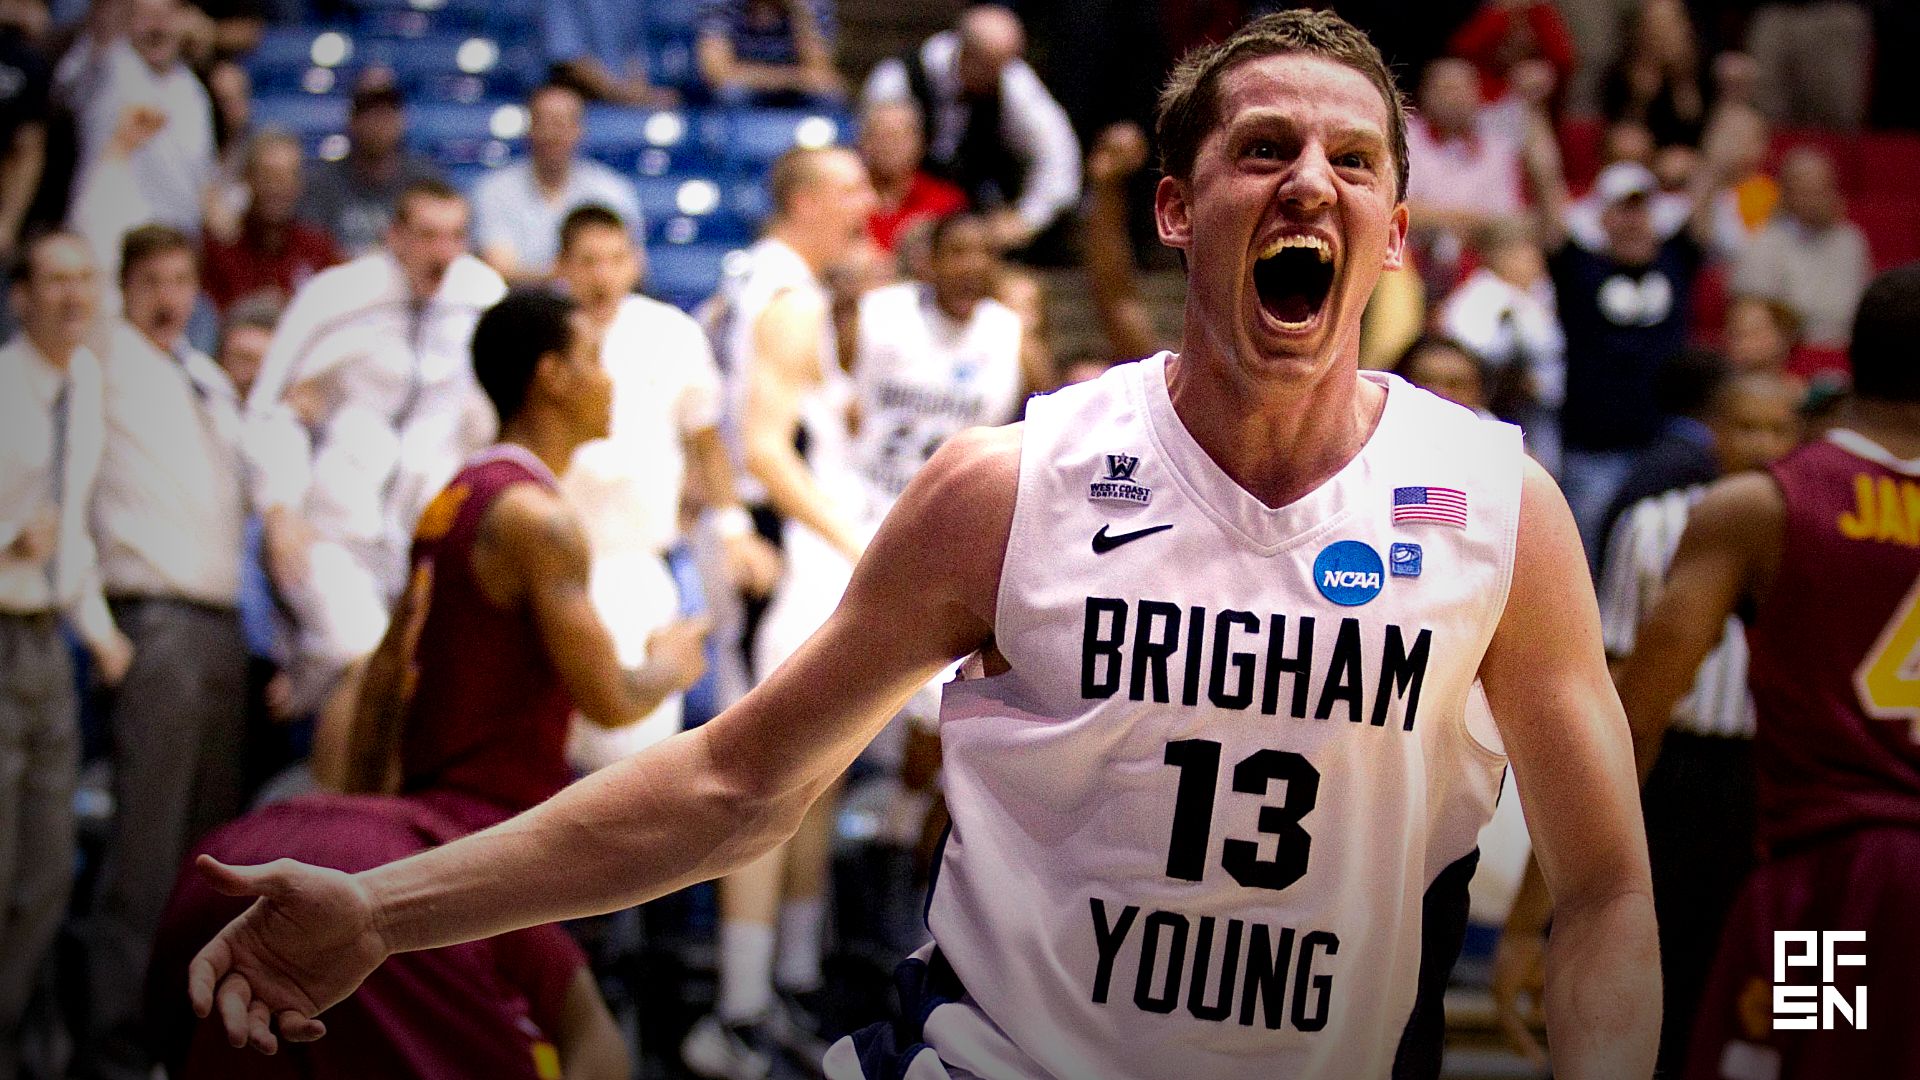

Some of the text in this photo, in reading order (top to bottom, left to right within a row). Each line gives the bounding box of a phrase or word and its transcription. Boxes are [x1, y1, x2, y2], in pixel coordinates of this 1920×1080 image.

[1090, 483, 1151, 496] WEST COAST
[1090, 491, 1148, 502] CONFERENCE
[1323, 570, 1380, 590] NCAA
[1081, 597, 1433, 731] BRIGHAM
[1163, 738, 1321, 891] 13
[1089, 897, 1340, 1032] YOUNG
